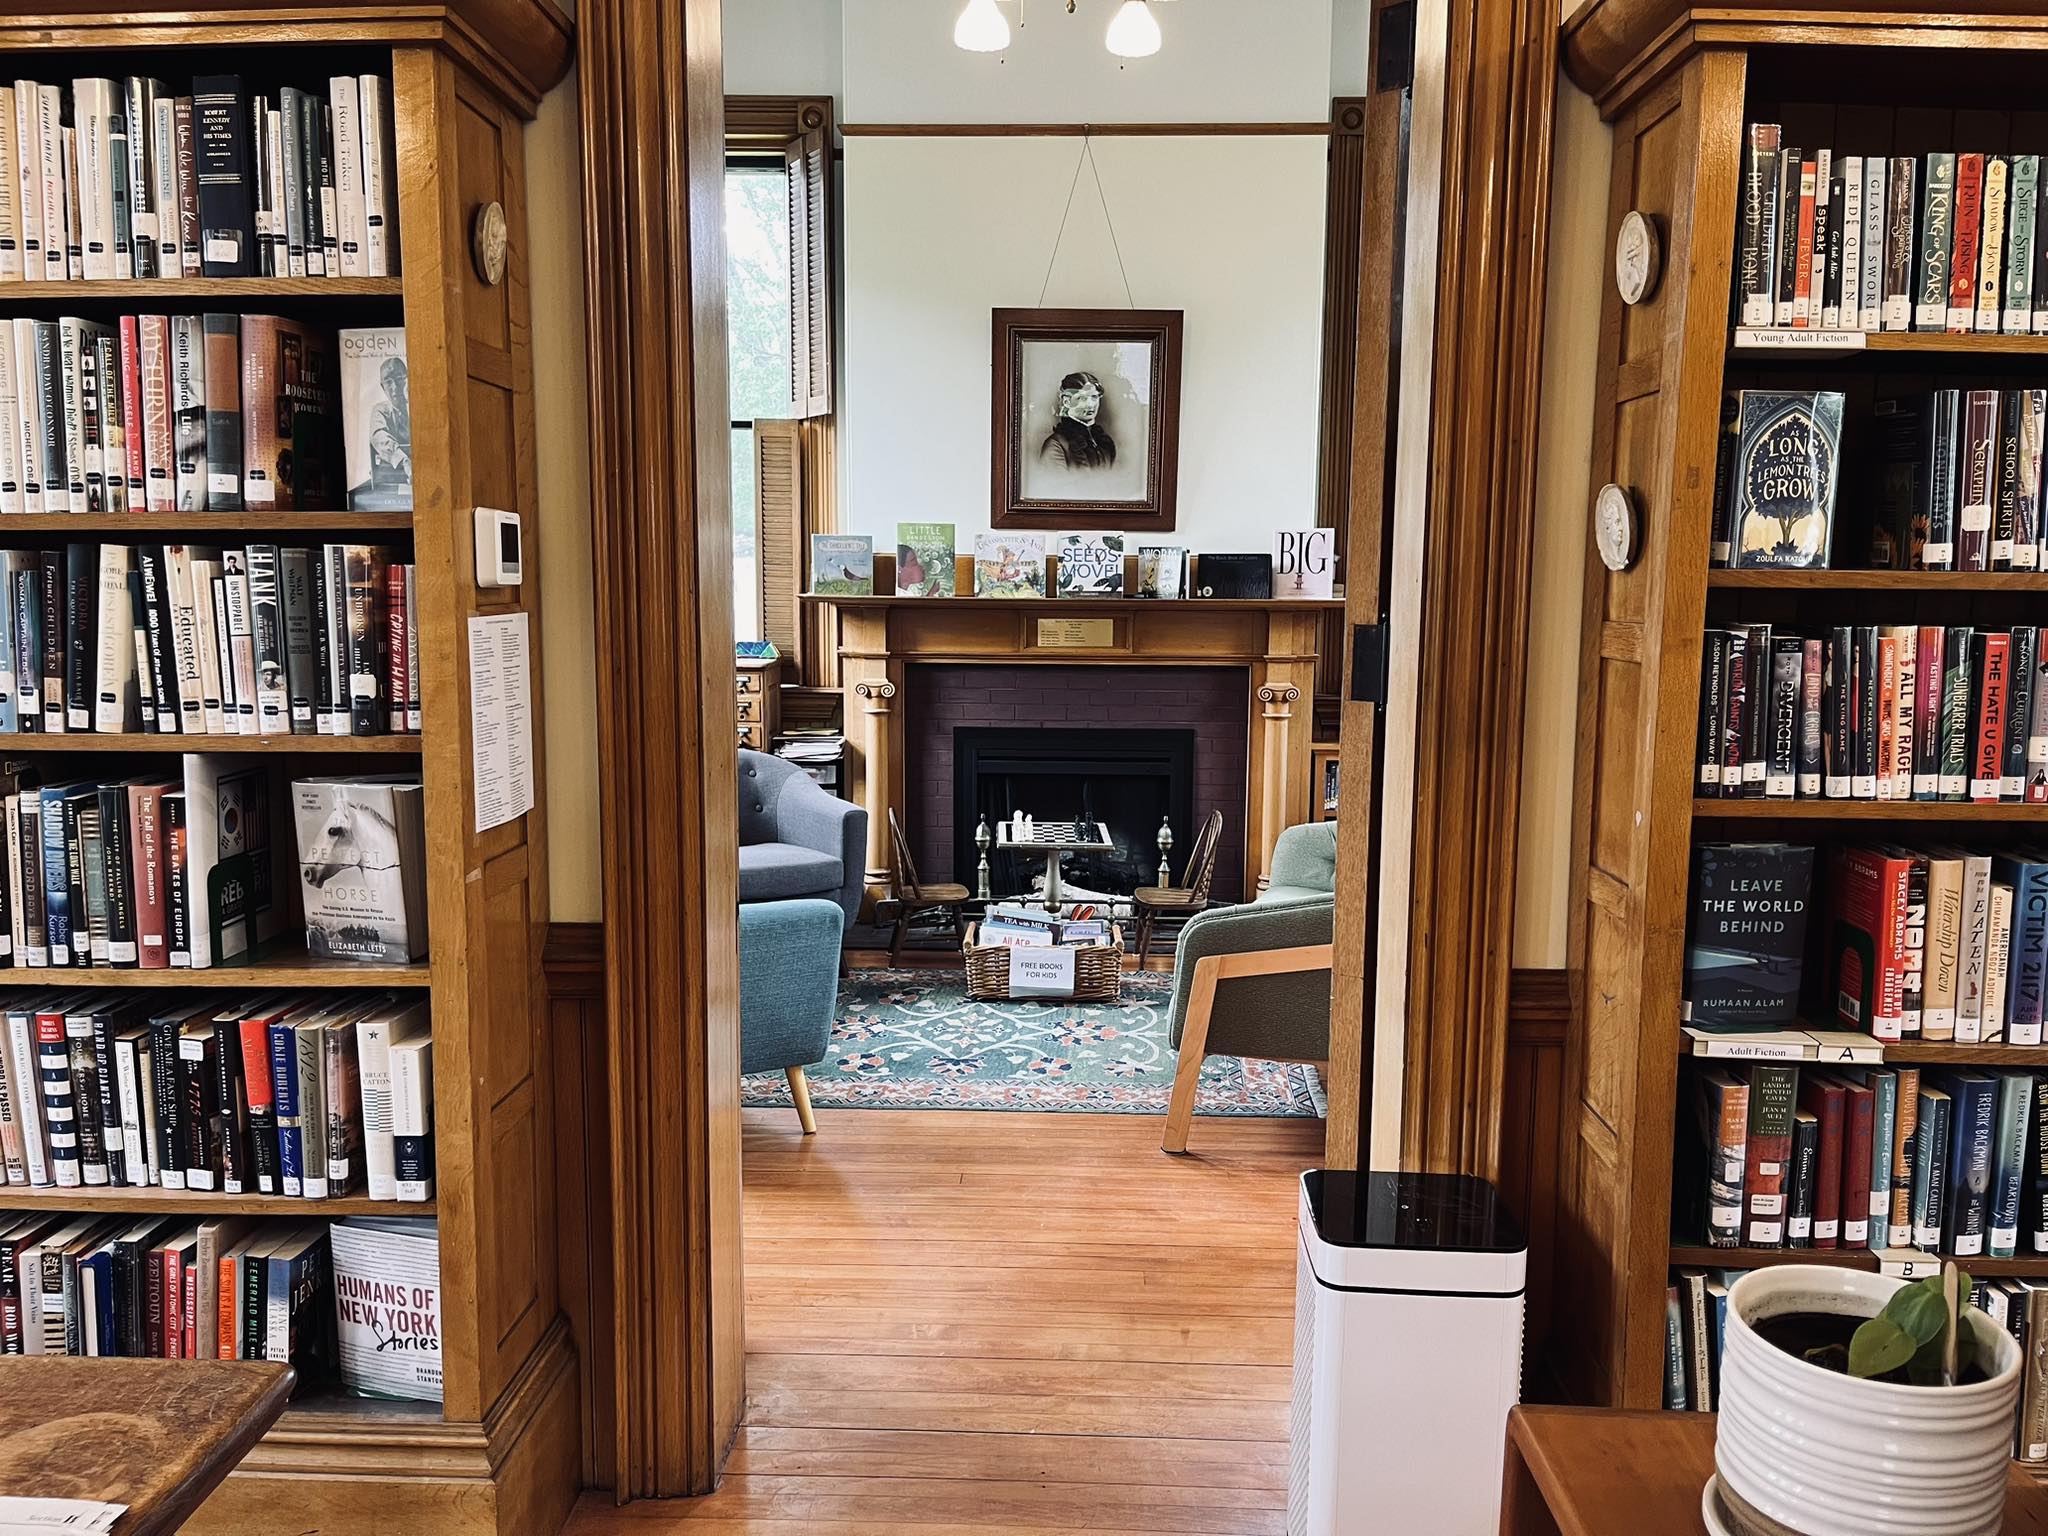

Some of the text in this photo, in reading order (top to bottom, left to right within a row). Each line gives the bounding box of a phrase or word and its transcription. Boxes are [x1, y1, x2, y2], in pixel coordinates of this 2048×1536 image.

[1762, 191, 1774, 261] CHILDREN
[1815, 208, 1827, 251] speak
[1845, 184, 1859, 301] RED QUEEN
[1924, 191, 1949, 303] KING OF SCARS
[2014, 187, 2030, 276] SIEGE STORM
[1798, 237, 1810, 279] FEVER
[1830, 231, 1839, 280] Go Ask Alice
[1753, 333, 1849, 344] Young Adult Fiction
[41, 329, 55, 447] SANDRA DAY O'CONNOR
[122, 329, 133, 427] PLAYING MYSELF
[179, 332, 191, 407] Keith Richards
[24, 421, 33, 463] MICHELLE
[181, 416, 192, 435] Life
[1769, 438, 1819, 457] LONG
[1758, 464, 1826, 484] LEMON TREES
[1763, 479, 1816, 500] GROW
[1932, 435, 1948, 529] MONUMENTS
[1999, 437, 2016, 538] SCHOOL SPIRITS
[908, 526, 941, 535] LITTLE
[1062, 548, 1119, 562] SEEDS
[1143, 549, 1178, 559] WORM
[1279, 532, 1327, 574] BIG
[252, 553, 276, 606] HANK
[289, 568, 297, 606] WHITMAN
[46, 565, 55, 670] Fortune's CHILDREN
[79, 576, 88, 631] VICTORIA
[230, 581, 243, 631] UNSTOPPABLE
[354, 588, 364, 641] UNBROKEN
[179, 606, 199, 680] Educated
[1711, 664, 1719, 705] REYNOLDS
[1805, 672, 1820, 697] LAND
[1929, 662, 1938, 713] TASTING LIGHT
[1709, 715, 1717, 736] LONG
[1897, 672, 1913, 775] ALL MY RAGE
[1950, 677, 1968, 764] SUNBEARER TRIALS
[1982, 652, 2002, 780] THE HATE U GIVE
[143, 796, 152, 812] The
[144, 816, 153, 831] Fall
[43, 800, 67, 891] SHADOW DIVERS
[146, 834, 153, 843] of
[68, 839, 80, 885] THE LONG WALK
[147, 861, 156, 905] Romanovs
[170, 832, 184, 947] THE GATES OF EUROPE
[325, 888, 377, 902] HORSE
[1703, 900, 1804, 913] THE WORLD
[1730, 879, 1783, 892] LEAVE
[49, 915, 57, 946] Kurson
[1004, 917, 1017, 925] TEA
[1031, 921, 1050, 930] MILK
[1719, 921, 1785, 933] BEHIND
[1894, 871, 1906, 960] STACEY ABRAMS
[2021, 870, 2048, 1002] VICTIM 2117
[1002, 936, 1031, 945] All Are
[1936, 888, 1959, 993] Watership Down
[1985, 896, 2002, 1008] CHIMAMANDA NGOZI ADICHIE
[1997, 927, 2008, 978] AMERICANAH
[1039, 962, 1063, 970] BOOKS
[1703, 999, 1784, 1007] RUMAAN ALAM
[273, 1033, 290, 1111] COKIE ROBERTS
[299, 1036, 318, 1082] 1812
[1727, 1047, 1786, 1057] Adult Fiction
[1839, 1047, 1854, 1060] A
[81, 1093, 89, 1118] HOME
[189, 1081, 200, 1116] 1775
[1902, 1078, 1916, 1143] ANXIOUS PEOPLE
[1972, 1093, 1992, 1171] FREDRIK BACKMAN
[1800, 1147, 1813, 1180] Emma
[2003, 1089, 2027, 1223] FREDRIK BACKMAN BEARTOWN
[1, 1247, 14, 1283] FEAR
[1902, 1262, 1914, 1276] B
[148, 1259, 160, 1324] ZEITOUN
[186, 1276, 194, 1328] MISSISSIPPI
[249, 1269, 257, 1343] EMERALD MILE
[337, 1274, 434, 1310] HUMANS OF
[4, 1306, 17, 1329] BOB
[269, 1302, 277, 1339] ALASKA
[339, 1299, 437, 1337] NEW YORK
[372, 1320, 438, 1352] Stories
